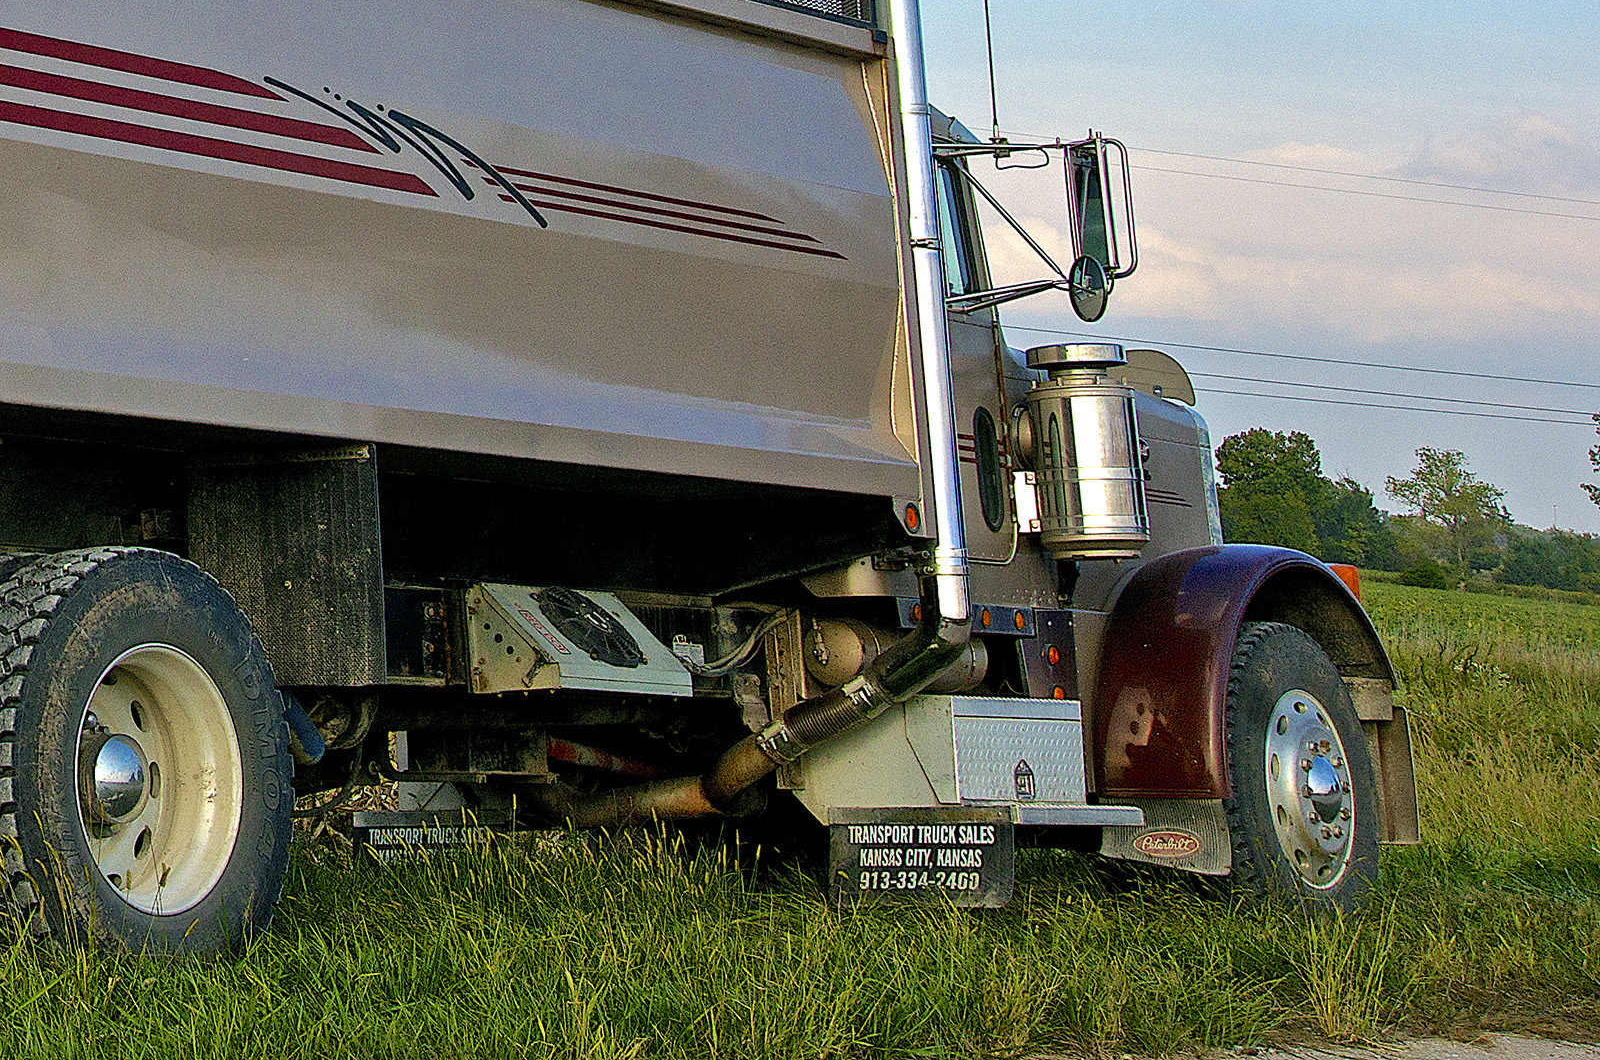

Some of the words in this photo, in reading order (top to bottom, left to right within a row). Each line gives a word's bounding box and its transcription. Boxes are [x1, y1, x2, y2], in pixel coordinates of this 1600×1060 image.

[368, 827, 424, 845] TRANSPORT
[427, 827, 458, 843] TRUCK
[848, 825, 915, 844] TRANSPORT
[917, 825, 956, 844] TRUCK
[958, 825, 995, 844] SALES
[860, 849, 903, 867] KANSAS
[905, 849, 933, 869] CITY,
[936, 849, 982, 867] KANSAS
[860, 871, 981, 890] 913-334-2460
